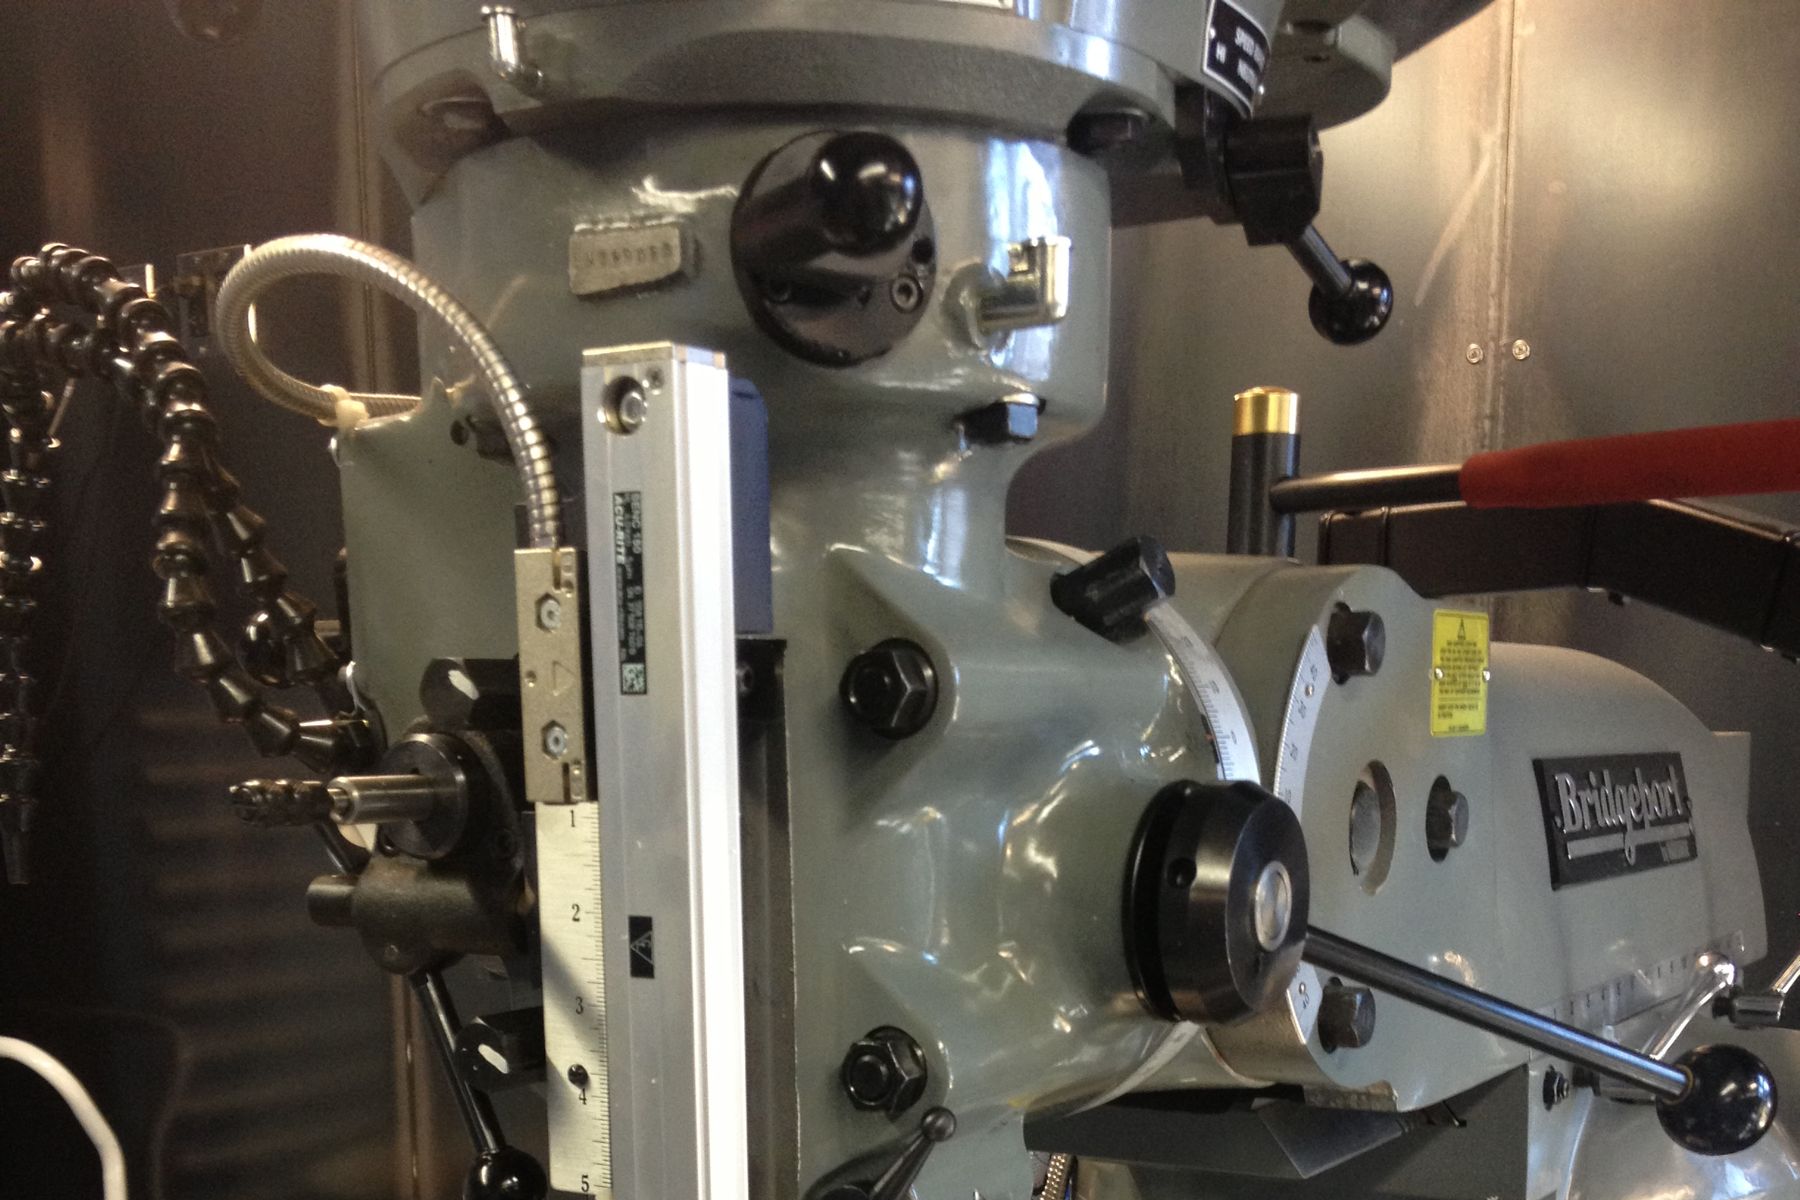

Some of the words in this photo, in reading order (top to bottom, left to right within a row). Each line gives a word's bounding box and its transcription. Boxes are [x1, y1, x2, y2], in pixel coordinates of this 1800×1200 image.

[614, 494, 625, 565] ACU-RITE
[570, 809, 576, 828] 1
[1555, 765, 1683, 866] Bridgeport
[572, 904, 580, 922] 2
[576, 996, 584, 1014] 3
[578, 1088, 587, 1105] 4
[581, 1175, 590, 1192] 5
